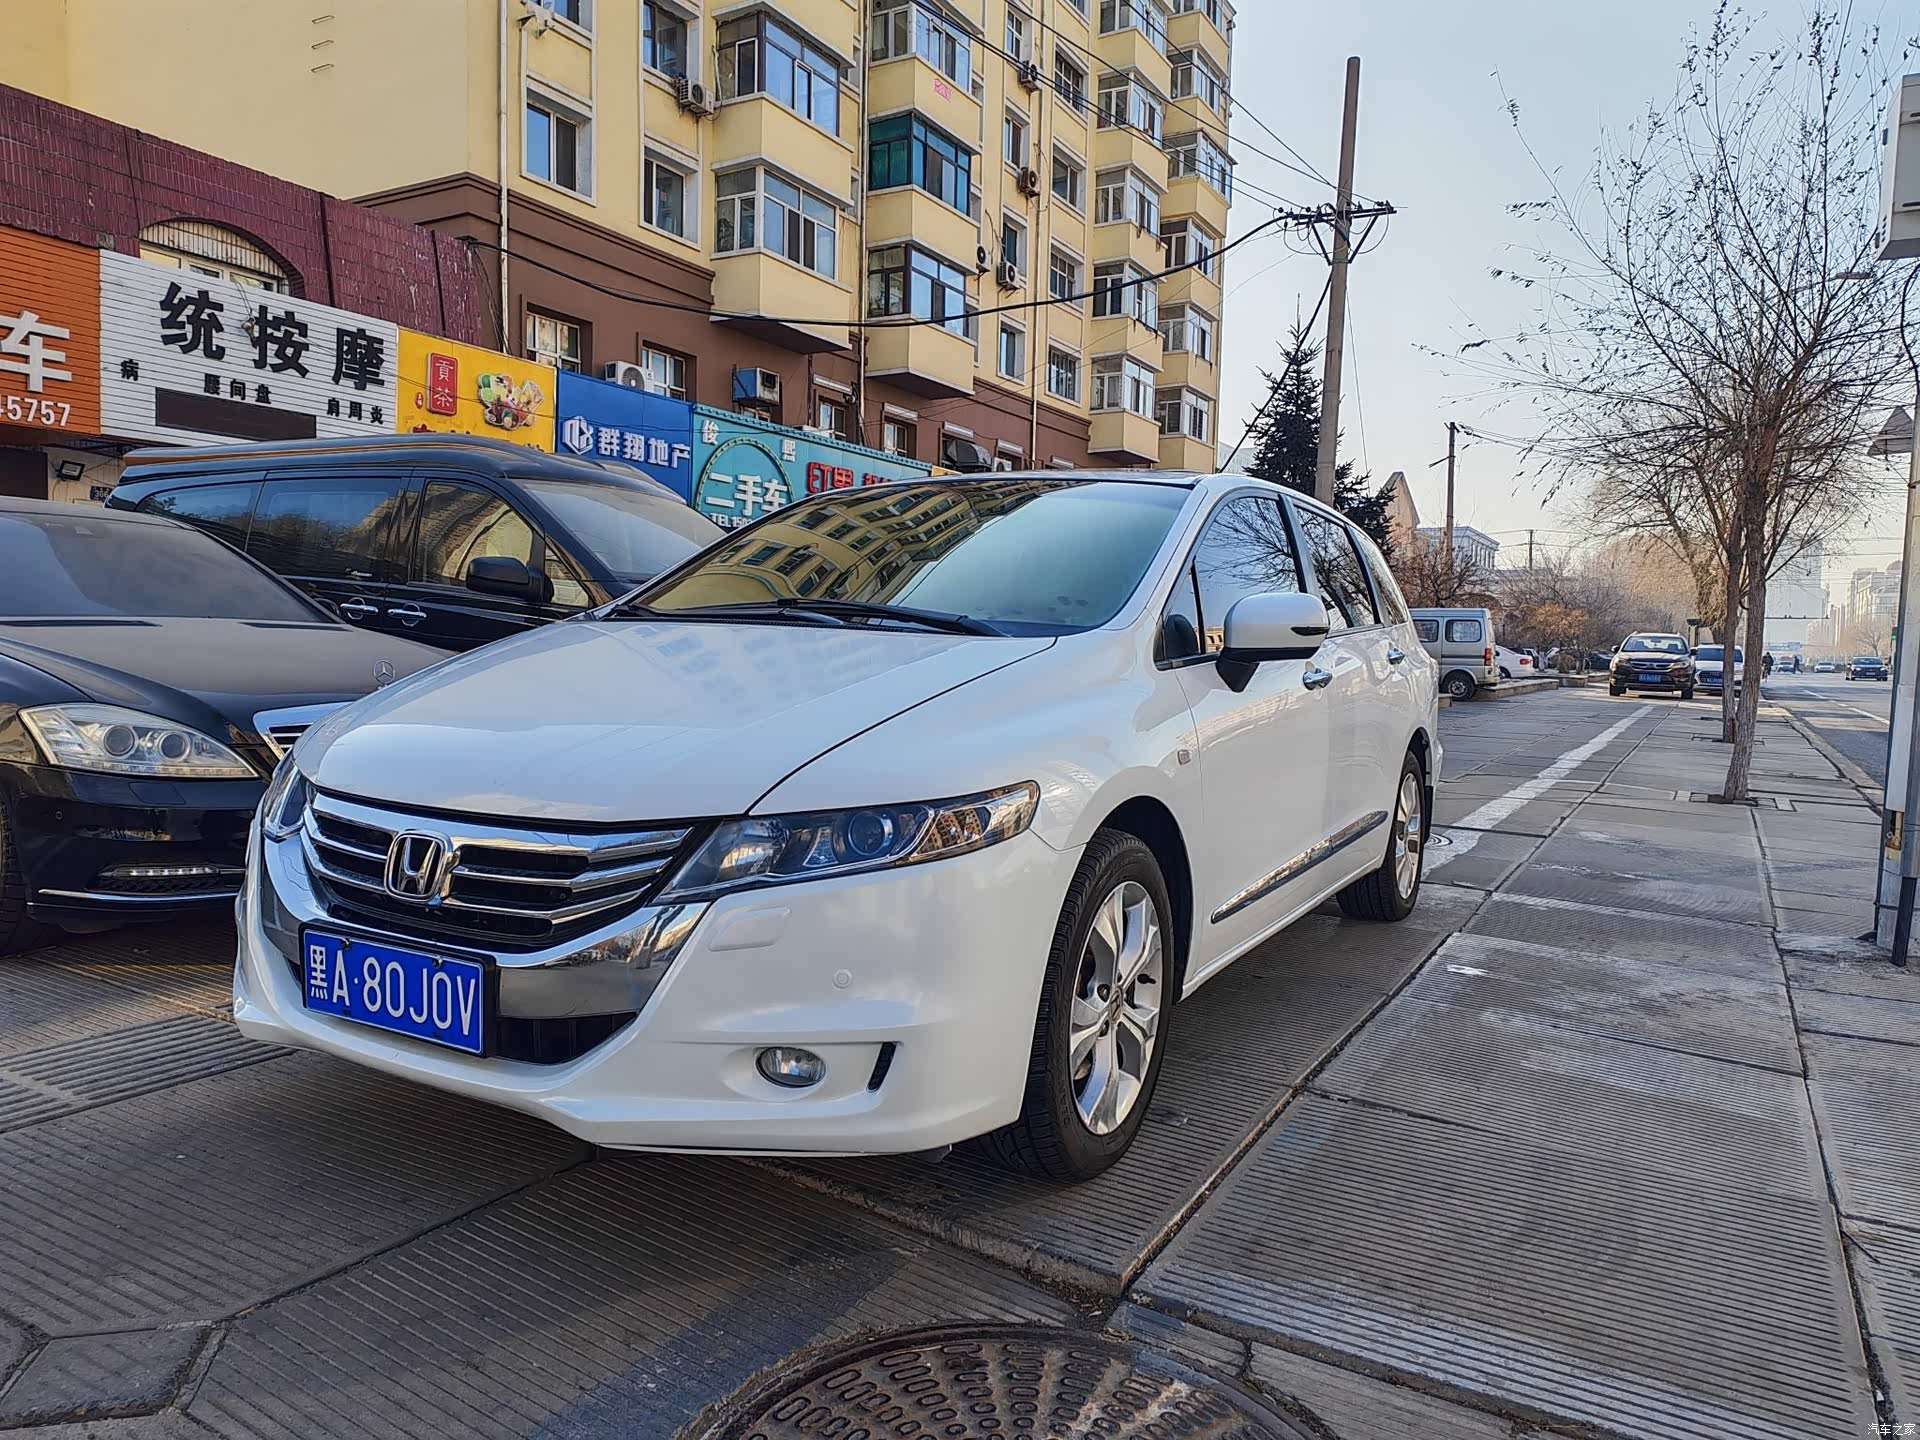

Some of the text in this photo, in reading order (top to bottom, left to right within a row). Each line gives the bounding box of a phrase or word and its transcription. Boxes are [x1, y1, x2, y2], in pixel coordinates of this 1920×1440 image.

[0, 310, 72, 393] 车
[160, 281, 385, 391] 统按摩
[121, 359, 140, 382] 病
[204, 373, 272, 404] 腰间盘
[326, 397, 384, 426] 肩周炎
[598, 427, 691, 469] 群翔地产
[705, 472, 788, 517] 二手车
[709, 512, 732, 528] TEL
